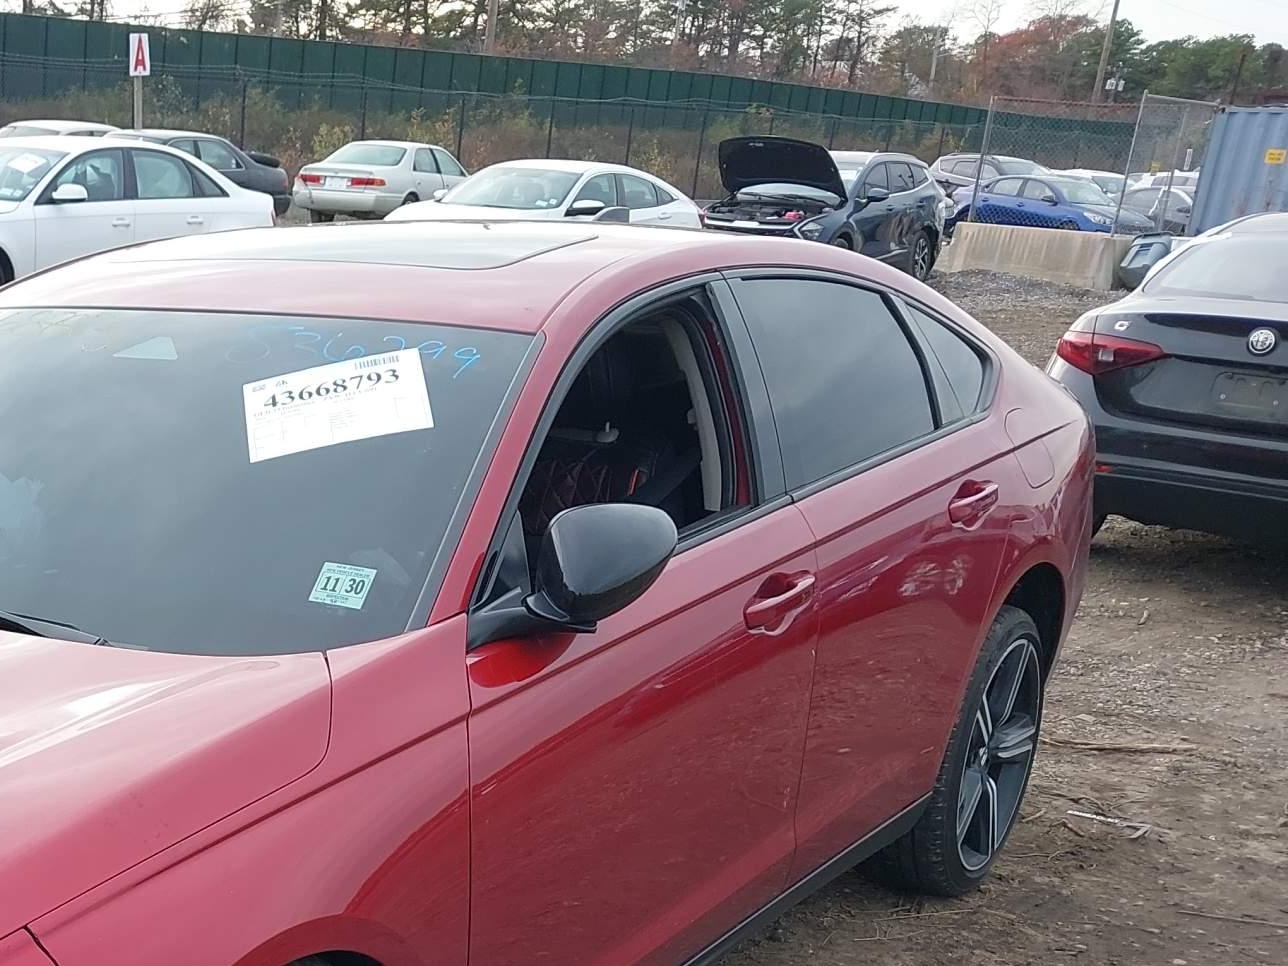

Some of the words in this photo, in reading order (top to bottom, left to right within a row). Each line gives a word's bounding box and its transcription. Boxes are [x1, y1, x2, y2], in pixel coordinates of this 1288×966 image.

[134, 34, 146, 72] A
[263, 368, 400, 408] 43668793
[320, 575, 340, 592] 11
[344, 578, 366, 595] 30
